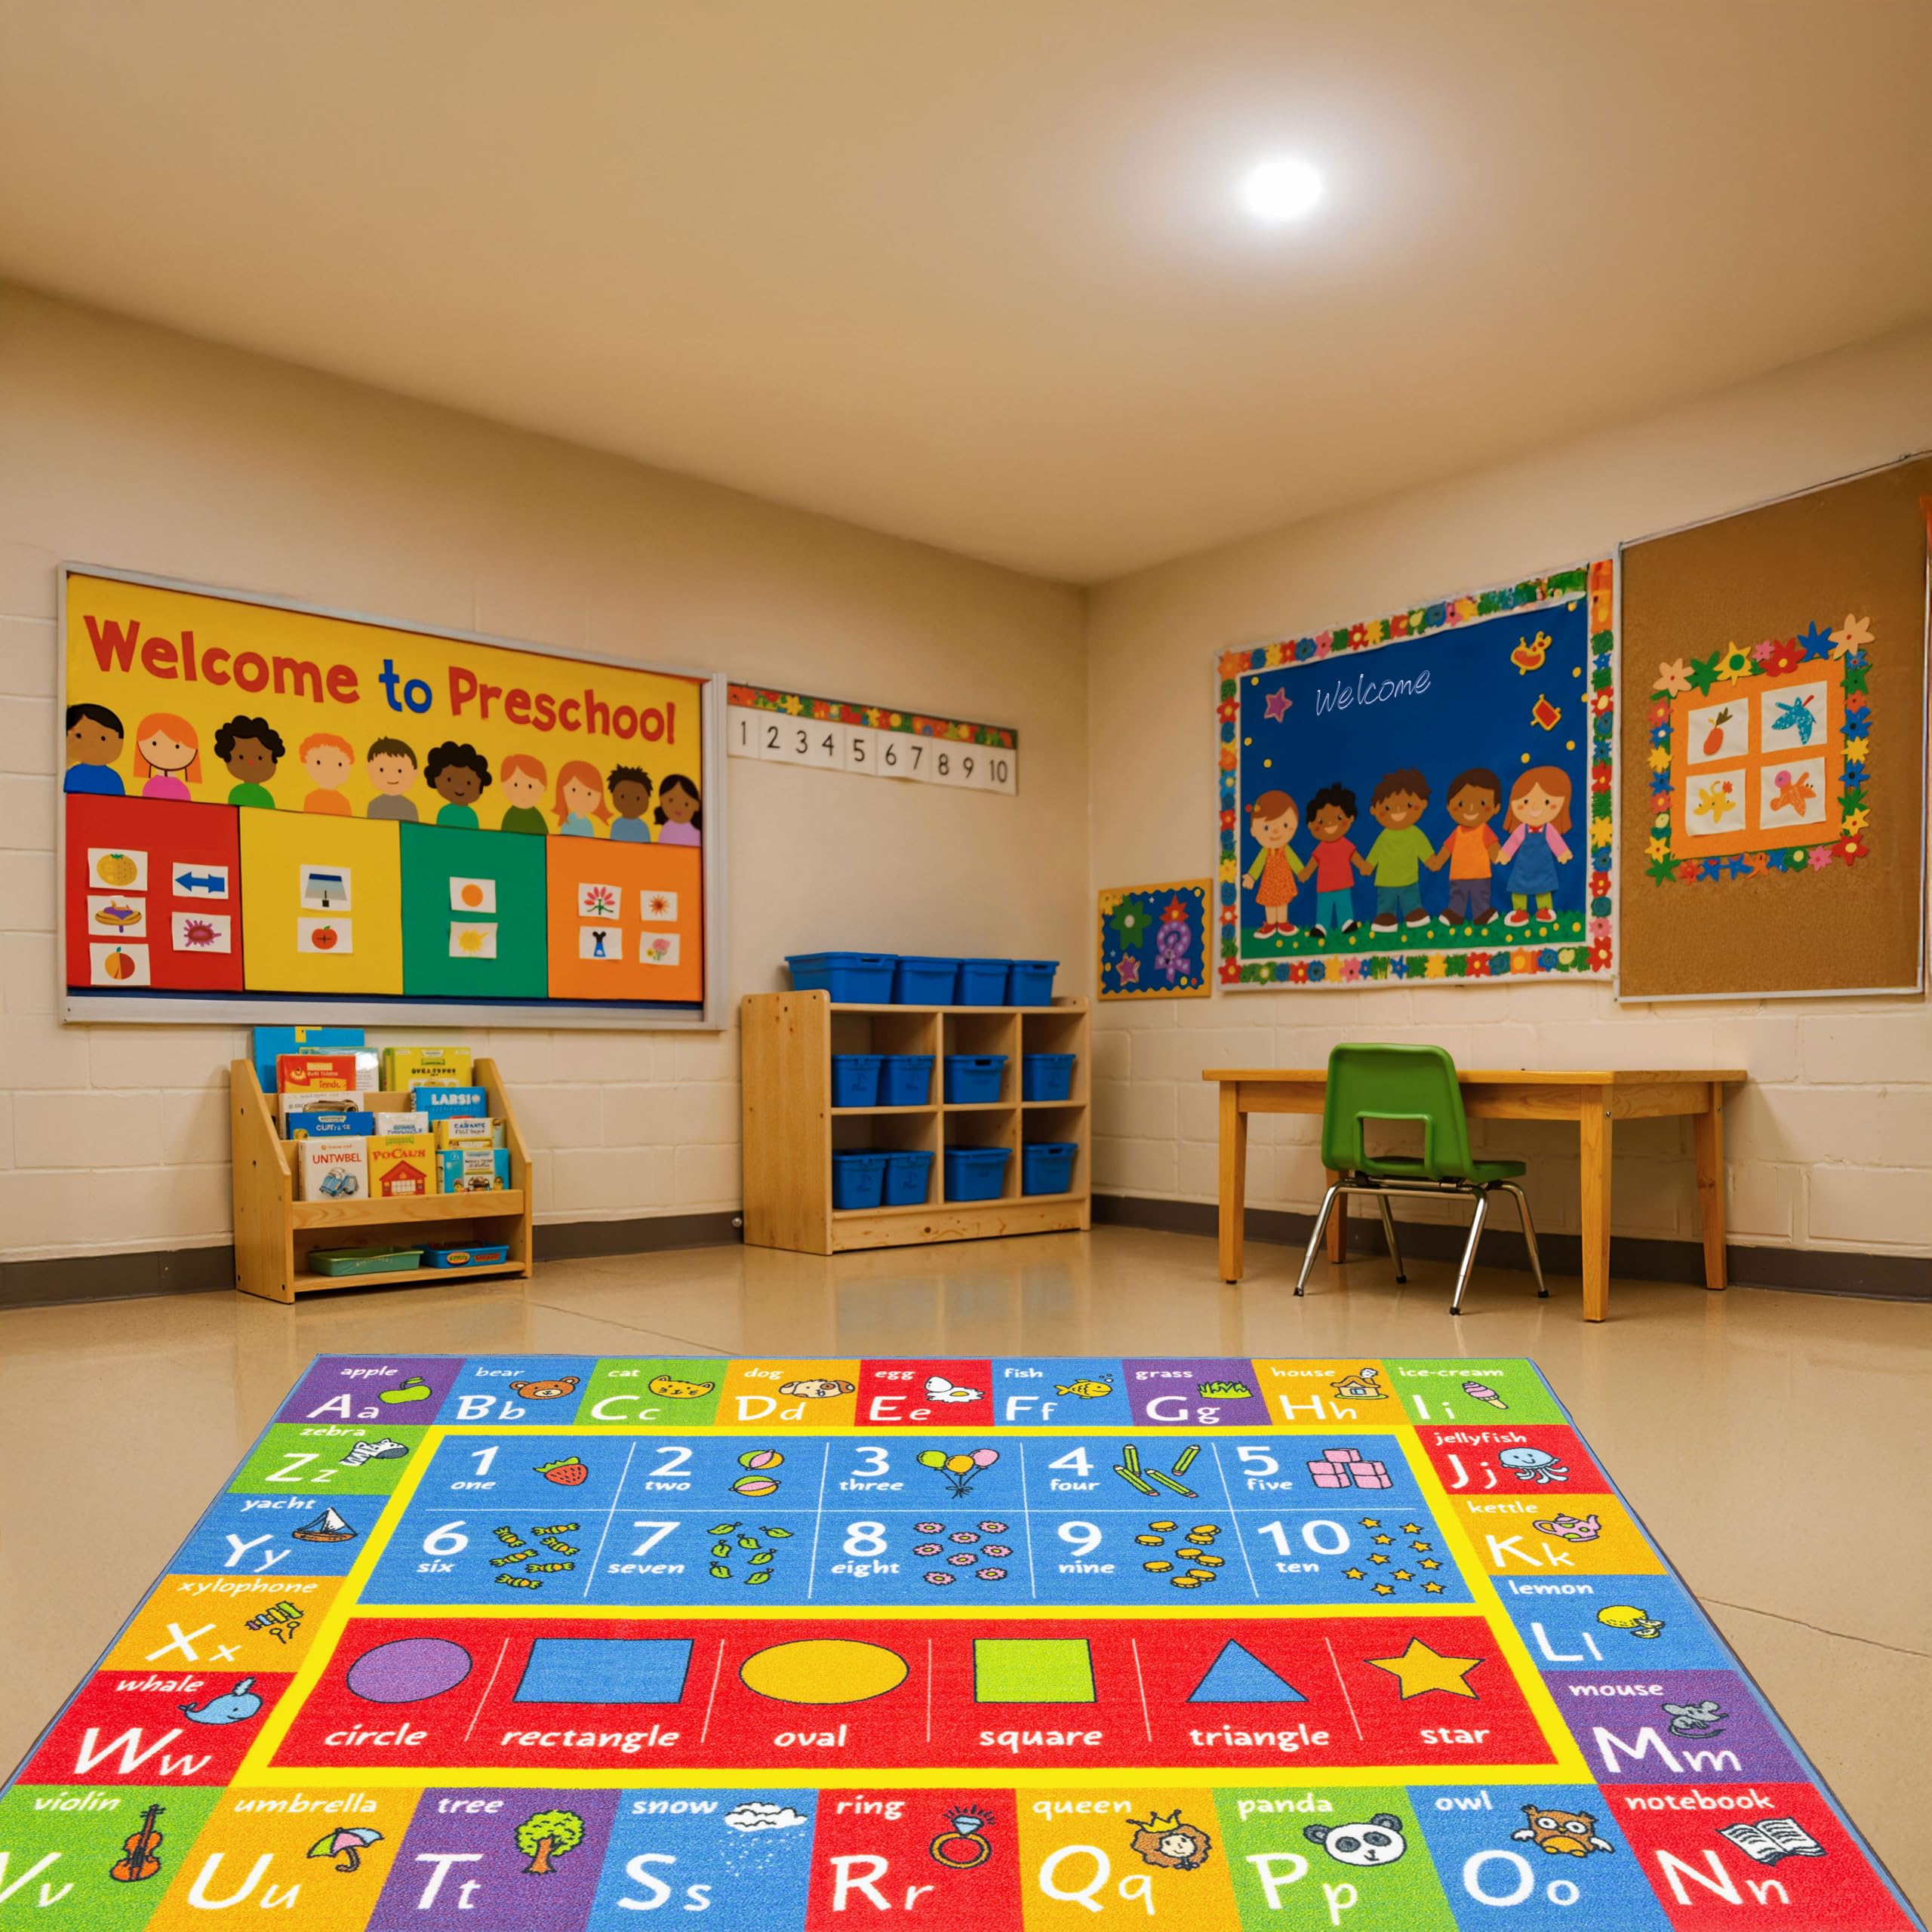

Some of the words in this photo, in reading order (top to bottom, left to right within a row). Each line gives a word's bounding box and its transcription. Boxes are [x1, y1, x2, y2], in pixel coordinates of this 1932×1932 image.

[83, 614, 360, 704] Welcome
[378, 658, 433, 714] to
[448, 666, 675, 745] Preschool
[1315, 669, 1432, 716] Welcome
[740, 720, 747, 746] 1
[765, 724, 781, 750] 2
[795, 729, 809, 755] 3
[820, 733, 835, 758] 4
[852, 737, 866, 763] 5
[884, 743, 898, 767] 6
[910, 745, 924, 771] 7
[937, 752, 950, 777] 8
[962, 755, 975, 779] 9
[989, 759, 1008, 784] 10
[340, 1365, 398, 1380] apple
[475, 1367, 525, 1377] bear
[608, 1369, 641, 1377] cat
[744, 1367, 783, 1380] dog
[875, 1371, 915, 1381] egg
[1004, 1367, 1043, 1378] fish
[1135, 1371, 1193, 1380] grass
[1271, 1367, 1335, 1377] house
[300, 1424, 365, 1437] zebra
[1433, 1431, 1527, 1447] jellyfish
[471, 1445, 500, 1476] 1
[648, 1446, 693, 1477] 2
[851, 1446, 890, 1477] 3
[1048, 1446, 1094, 1477] 4
[1240, 1446, 1279, 1477] 5
[451, 1481, 497, 1490] one
[645, 1481, 691, 1491] two
[838, 1478, 904, 1491] three
[1050, 1478, 1100, 1491] four
[1247, 1478, 1293, 1491] five
[240, 1496, 316, 1512] yacht
[1467, 1500, 1537, 1513] kettle
[423, 1520, 469, 1556] 6
[630, 1521, 681, 1557] 7
[842, 1521, 888, 1557] 8
[1057, 1521, 1103, 1557] 9
[1257, 1519, 1351, 1556] 10
[416, 1558, 455, 1573] six
[608, 1563, 685, 1574] seven
[831, 1559, 900, 1578] eight
[1058, 1560, 1115, 1574] nine
[1275, 1561, 1320, 1574] ten
[177, 1578, 318, 1597] xylophone
[1508, 1580, 1595, 1595] lemon
[115, 1674, 205, 1693] whale
[1568, 1684, 1664, 1697] mouse
[325, 1722, 428, 1746] circle
[500, 1724, 680, 1754] rectangle
[774, 1724, 848, 1747] oval
[979, 1730, 1103, 1754] square
[1189, 1723, 1330, 1752] triangle
[1420, 1727, 1490, 1745] star
[34, 1791, 120, 1811] violin
[234, 1792, 377, 1814] umbrella
[438, 1798, 504, 1814] tree
[632, 1800, 718, 1815] snow
[836, 1794, 906, 1821] ring
[1237, 1794, 1333, 1821] panda
[1435, 1789, 1493, 1811] owl
[1624, 1791, 1775, 1810] notebook
[1032, 1800, 1132, 1820] queen
